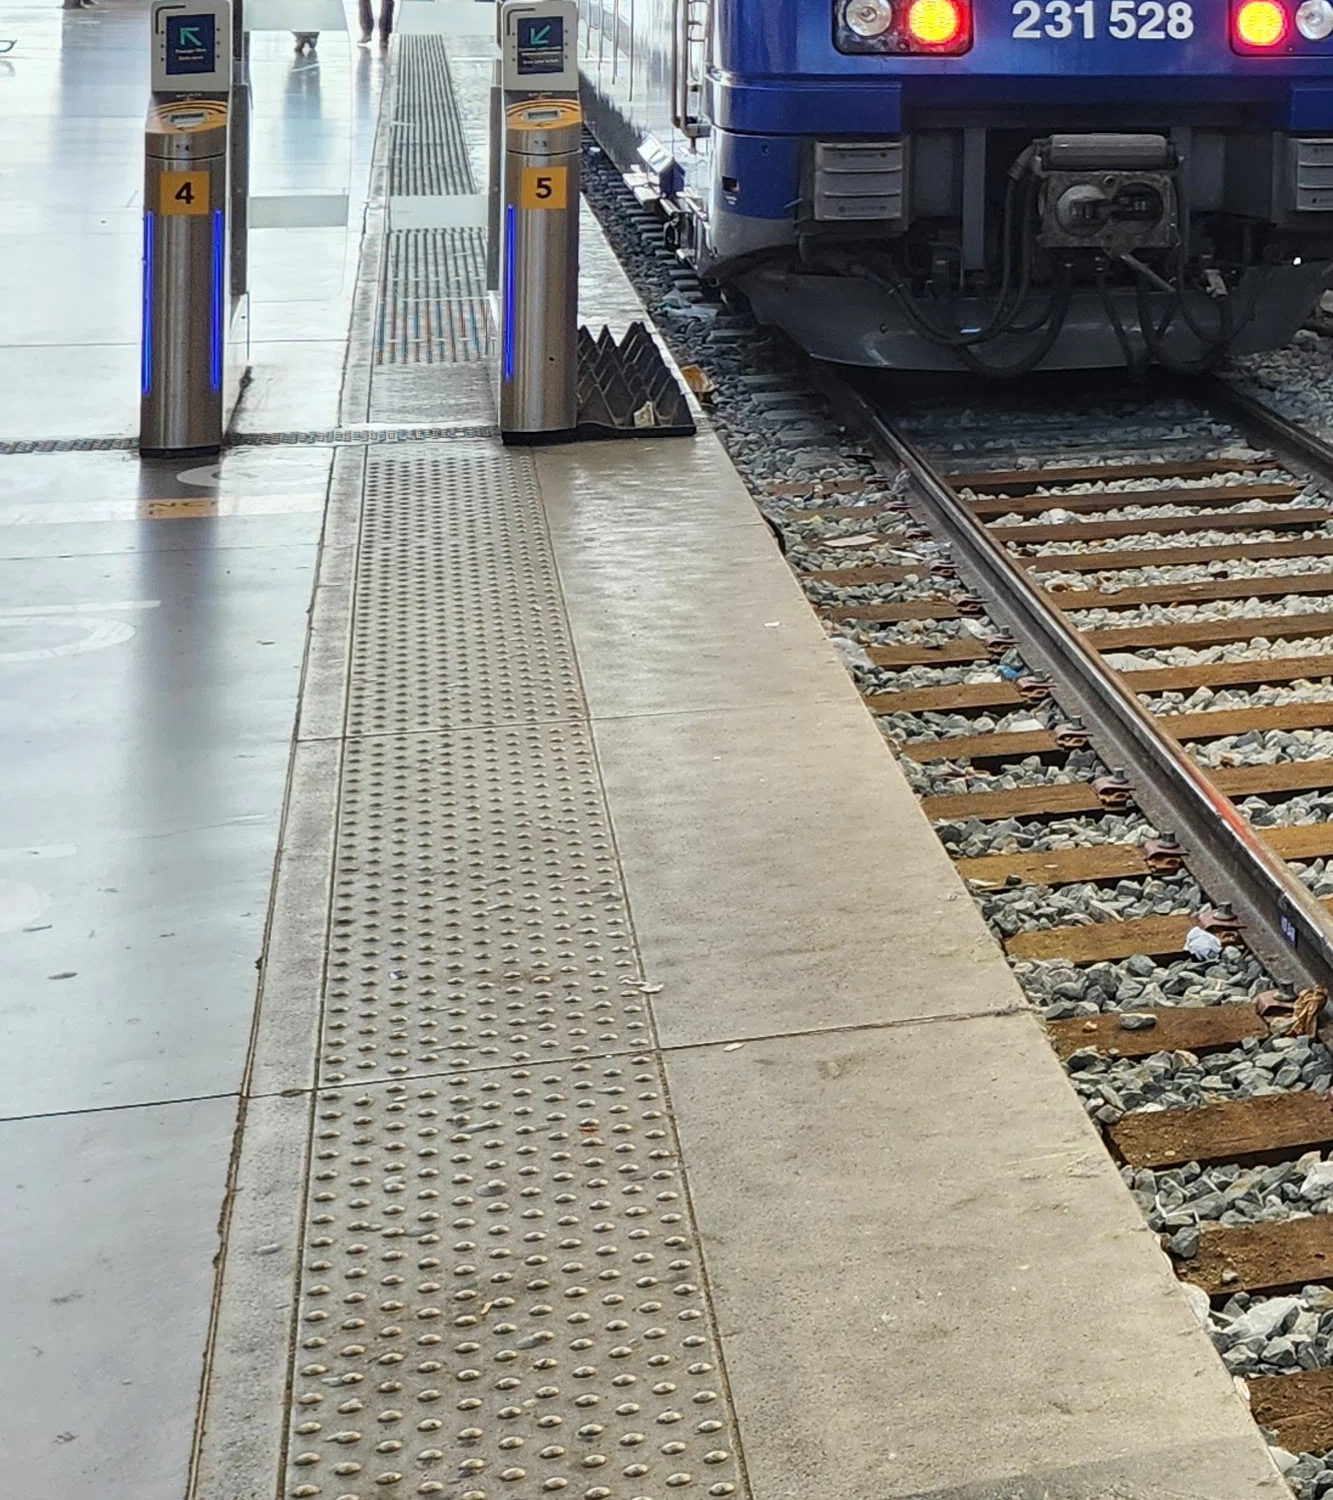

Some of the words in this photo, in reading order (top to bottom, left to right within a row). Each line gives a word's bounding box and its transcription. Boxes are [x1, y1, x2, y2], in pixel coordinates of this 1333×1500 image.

[1011, 0, 1096, 39] 231
[1108, 0, 1195, 40] 528
[174, 181, 196, 205] 4
[535, 177, 553, 199] 5
